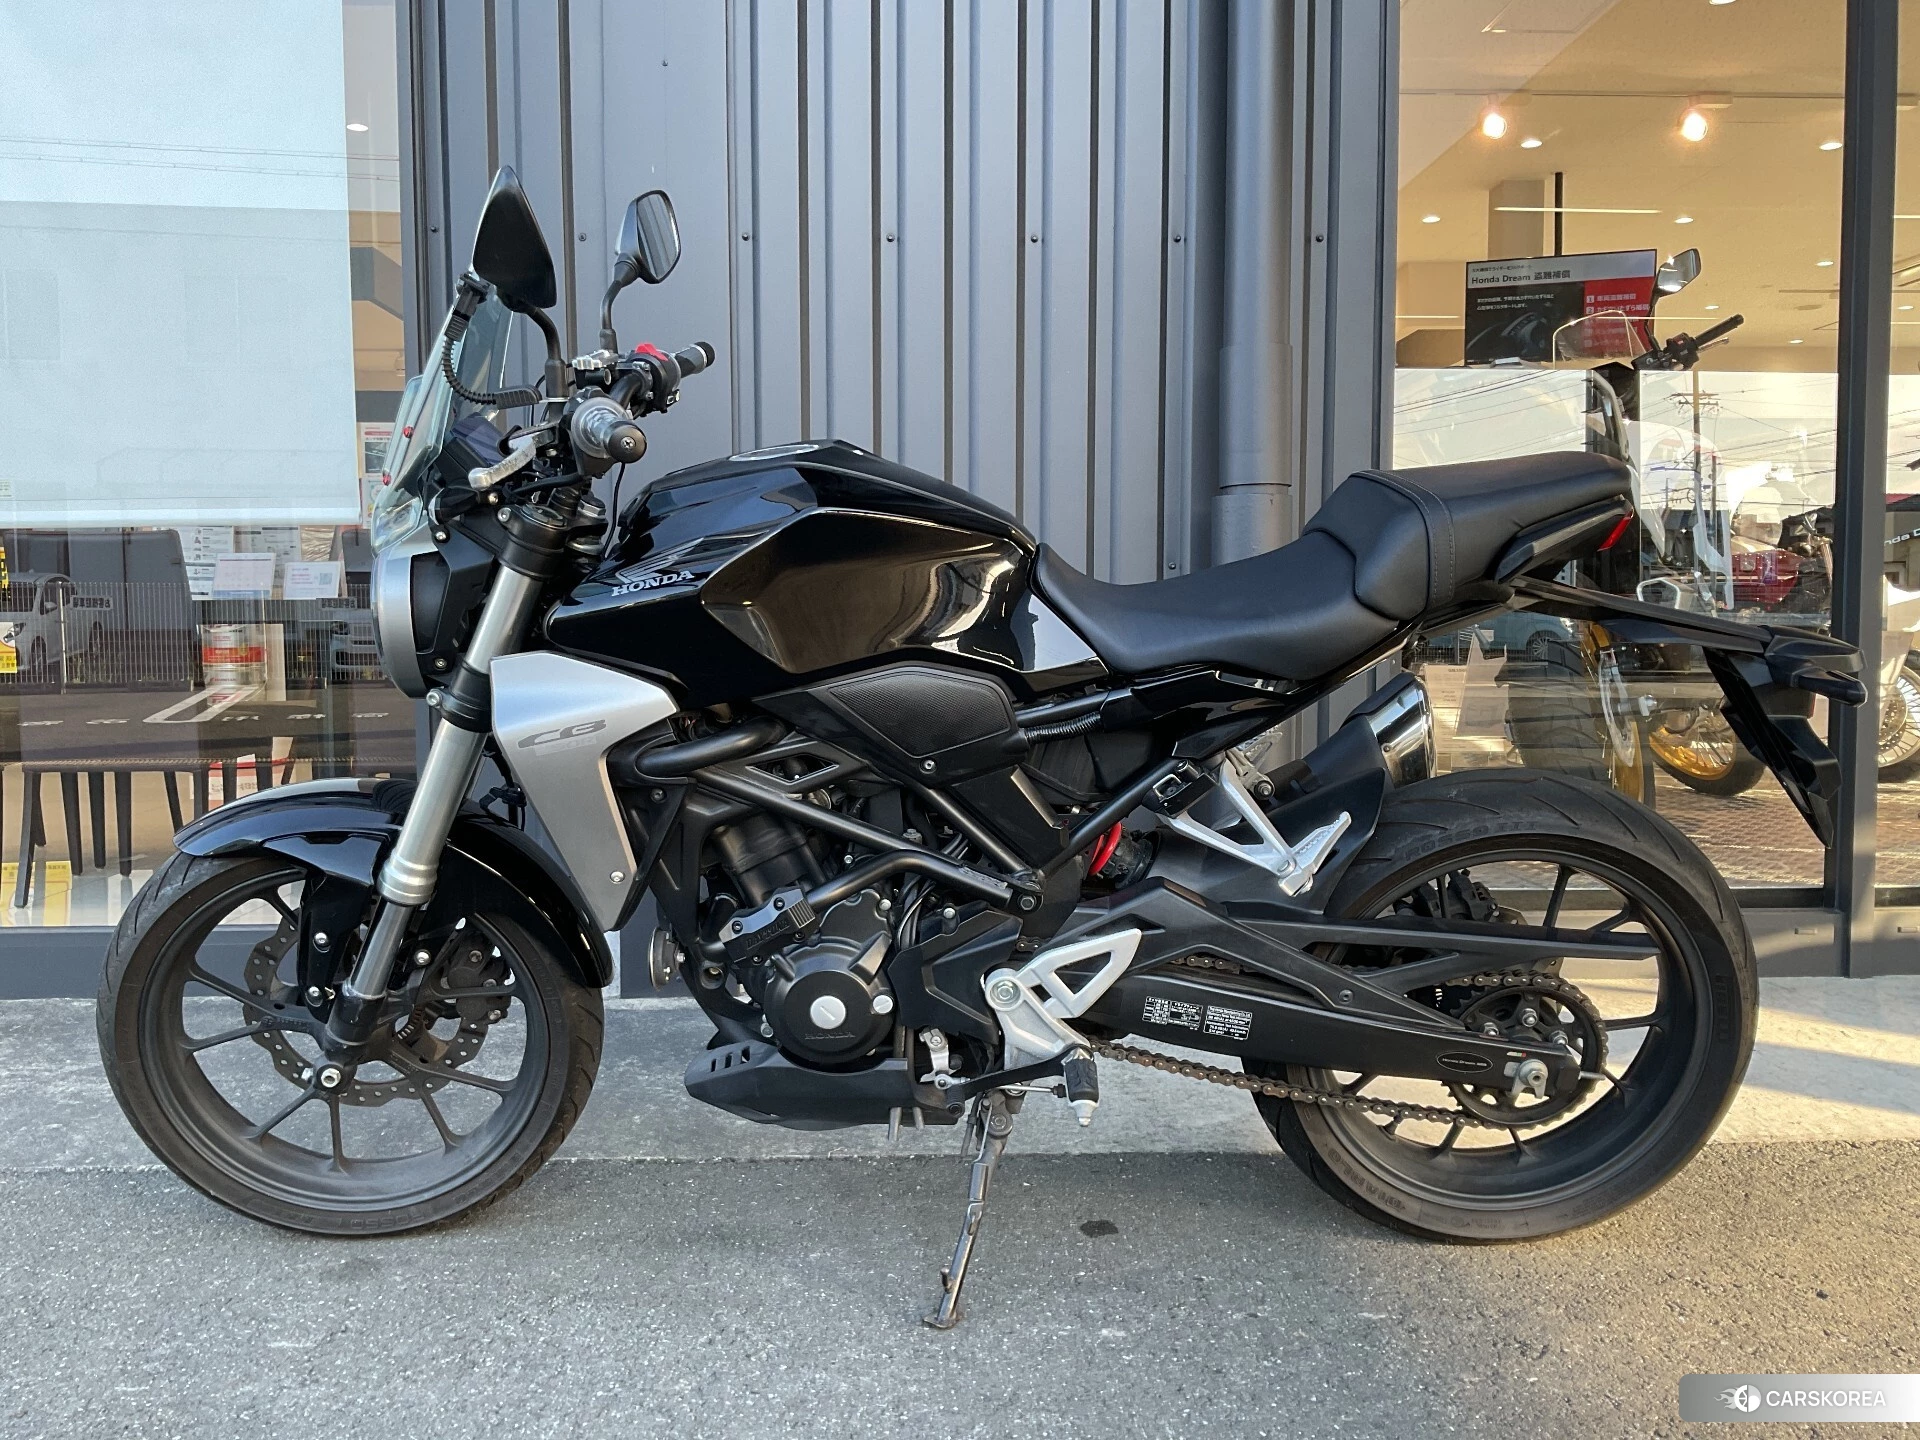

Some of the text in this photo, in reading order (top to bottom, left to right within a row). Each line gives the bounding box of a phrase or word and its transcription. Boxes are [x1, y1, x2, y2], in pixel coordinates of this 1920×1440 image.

[1471, 275, 1500, 285] Honda
[1502, 274, 1531, 283] Dream
[611, 570, 695, 597] HONDA
[518, 719, 606, 749] CB
